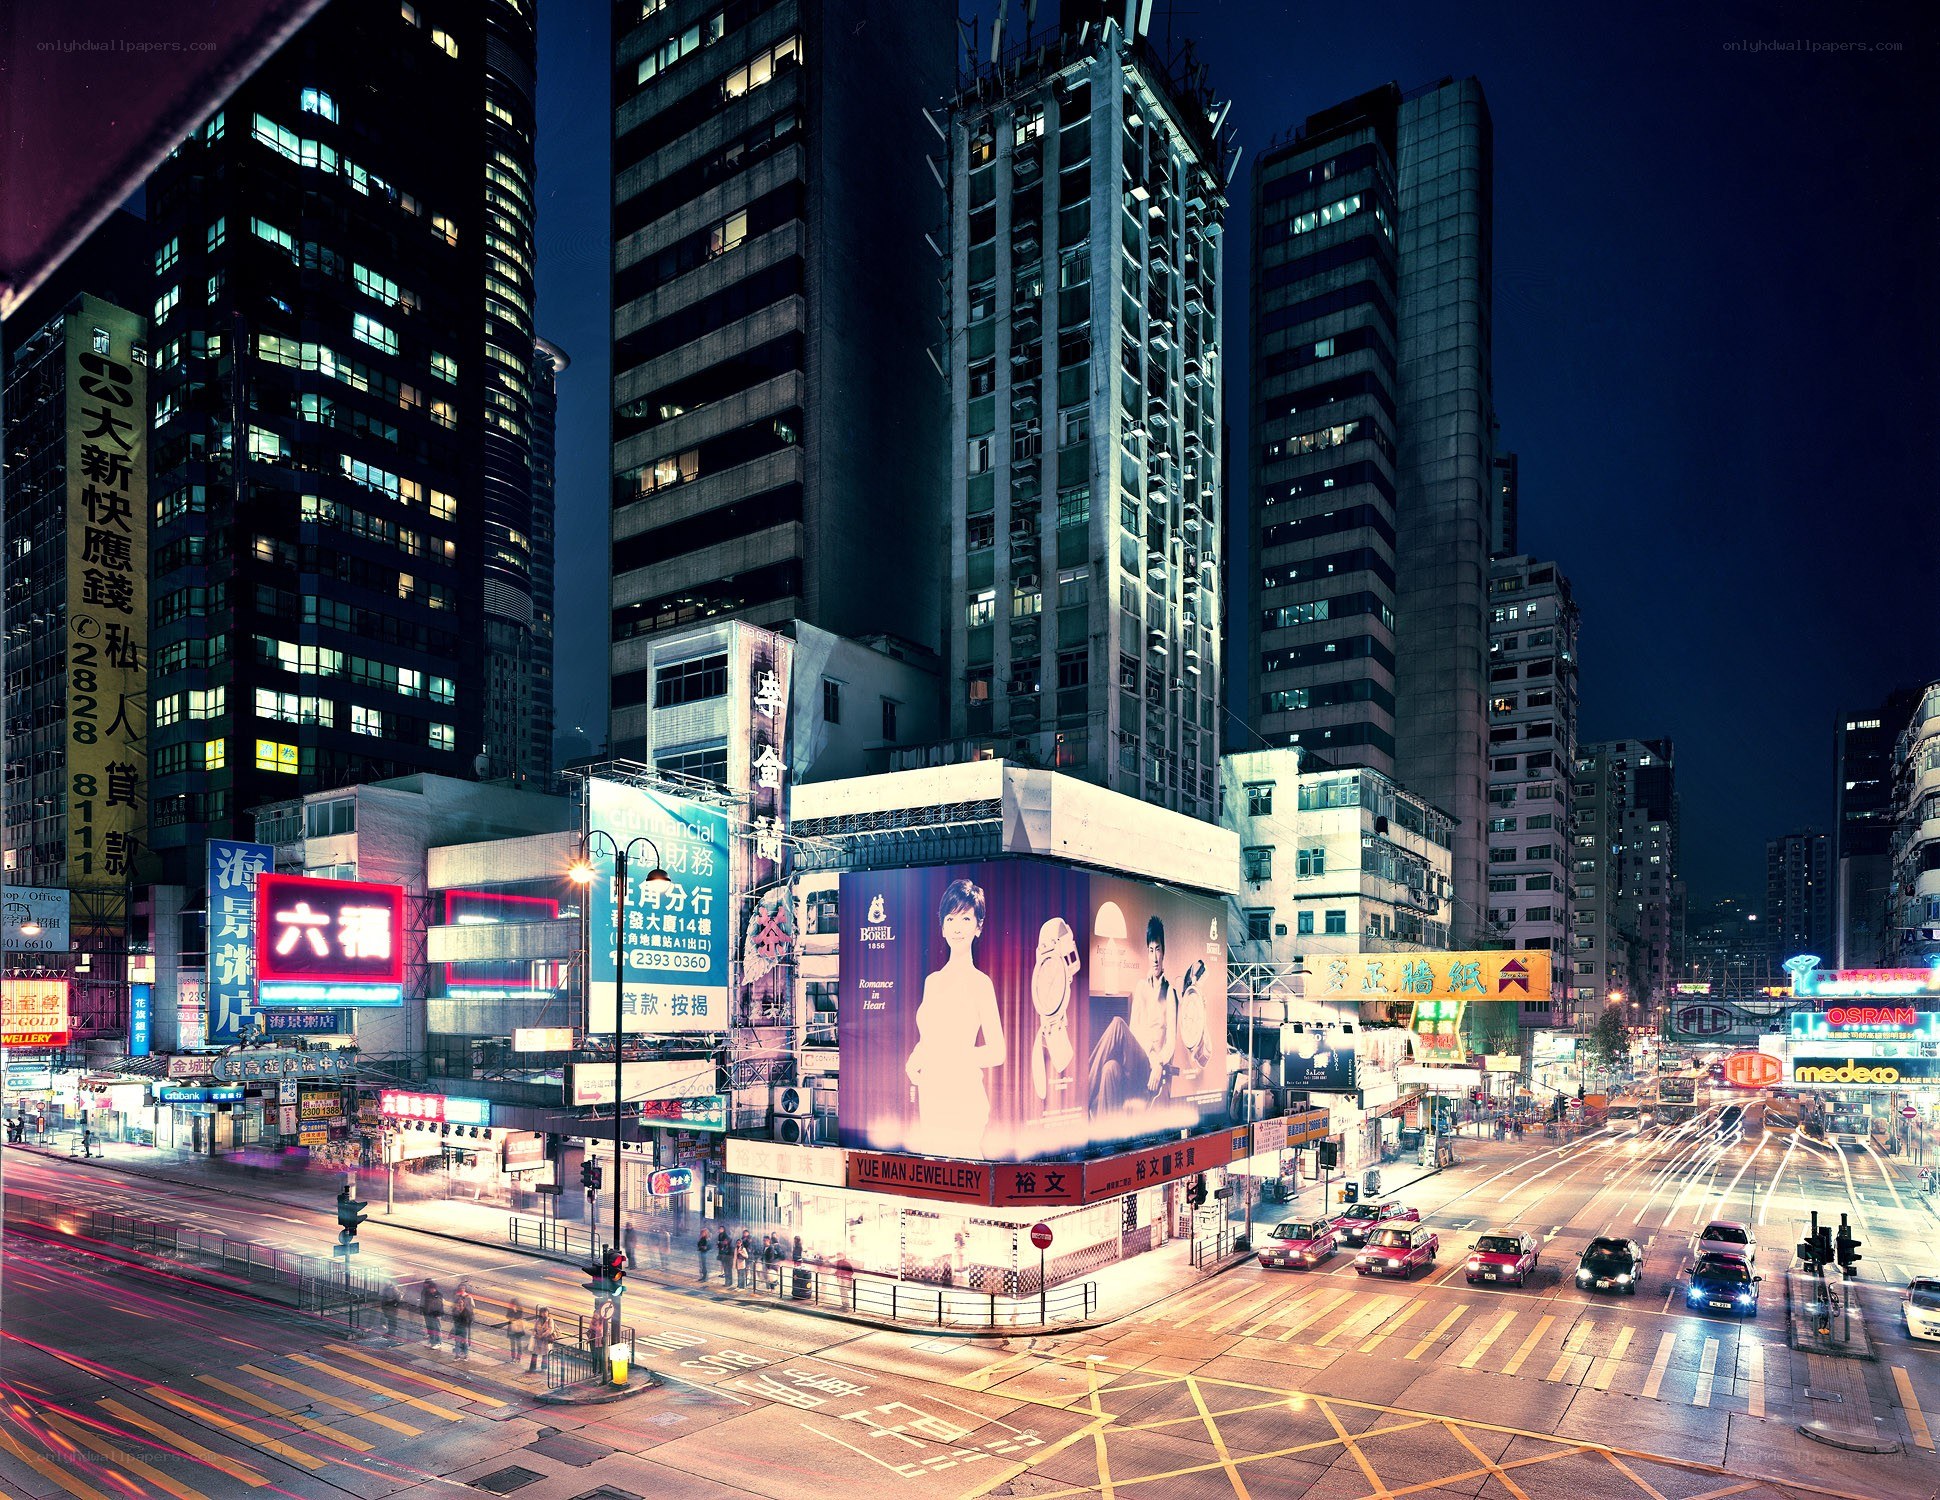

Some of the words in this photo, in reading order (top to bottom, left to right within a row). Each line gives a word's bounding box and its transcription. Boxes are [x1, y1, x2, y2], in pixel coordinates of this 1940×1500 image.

[80, 405, 133, 615] 大新快應錢
[71, 642, 98, 745] 2828
[104, 621, 139, 877] 私人貸款
[72, 773, 98, 875] 8111
[28, 892, 62, 902] Office
[275, 900, 392, 959] 六福
[859, 926, 896, 942] BOREL
[24, 939, 53, 949] 6610
[867, 942, 886, 950] 1856
[635, 952, 670, 967] 2393
[674, 953, 707, 969] 0360
[858, 978, 894, 990] Romance
[871, 990, 880, 1000] in
[862, 1000, 886, 1011] Heart
[1827, 1006, 1917, 1026] OSRAM
[134, 998, 147, 1044] 花旗銀行
[269, 1015, 335, 1029] 海景粥店
[1679, 1006, 1728, 1035] PLC
[1729, 1055, 1779, 1084] PLC
[1794, 1058, 1900, 1083] medeco
[164, 1090, 201, 1101] citibank
[302, 1108, 321, 1116] 2300
[856, 1157, 879, 1177] YUE
[881, 1159, 907, 1181] MAN
[908, 1162, 983, 1191] JEWELLERY
[1135, 1156, 1160, 1182] 裕文
[1015, 1169, 1067, 1195] 裕文
[679, 1348, 772, 1377] BUS
